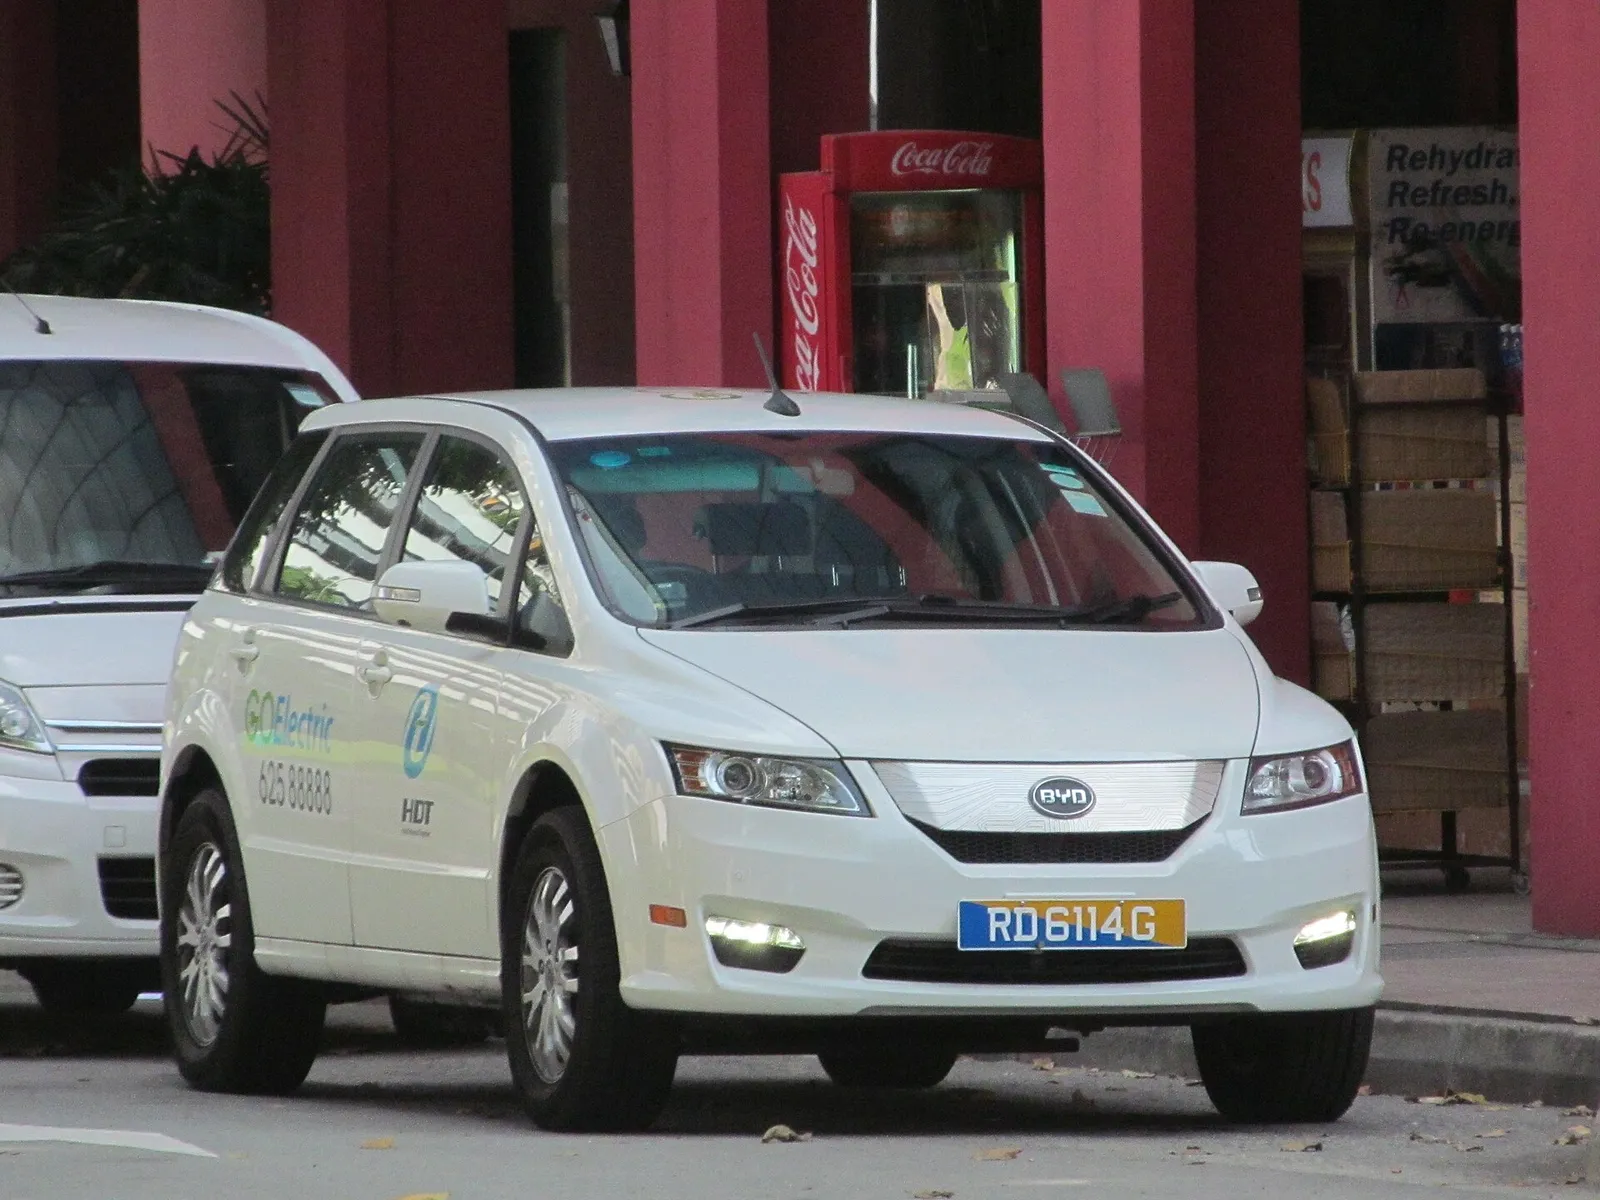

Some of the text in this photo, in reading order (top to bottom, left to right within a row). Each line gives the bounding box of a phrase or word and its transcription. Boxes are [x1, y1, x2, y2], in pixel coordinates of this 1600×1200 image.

[890, 141, 994, 176] Coca-Cola
[1387, 143, 1519, 176] Rehydra
[1303, 151, 1322, 212] S
[784, 193, 820, 392] ca-Cola
[401, 798, 434, 825] HDT
[1039, 788, 1088, 804] BYD
